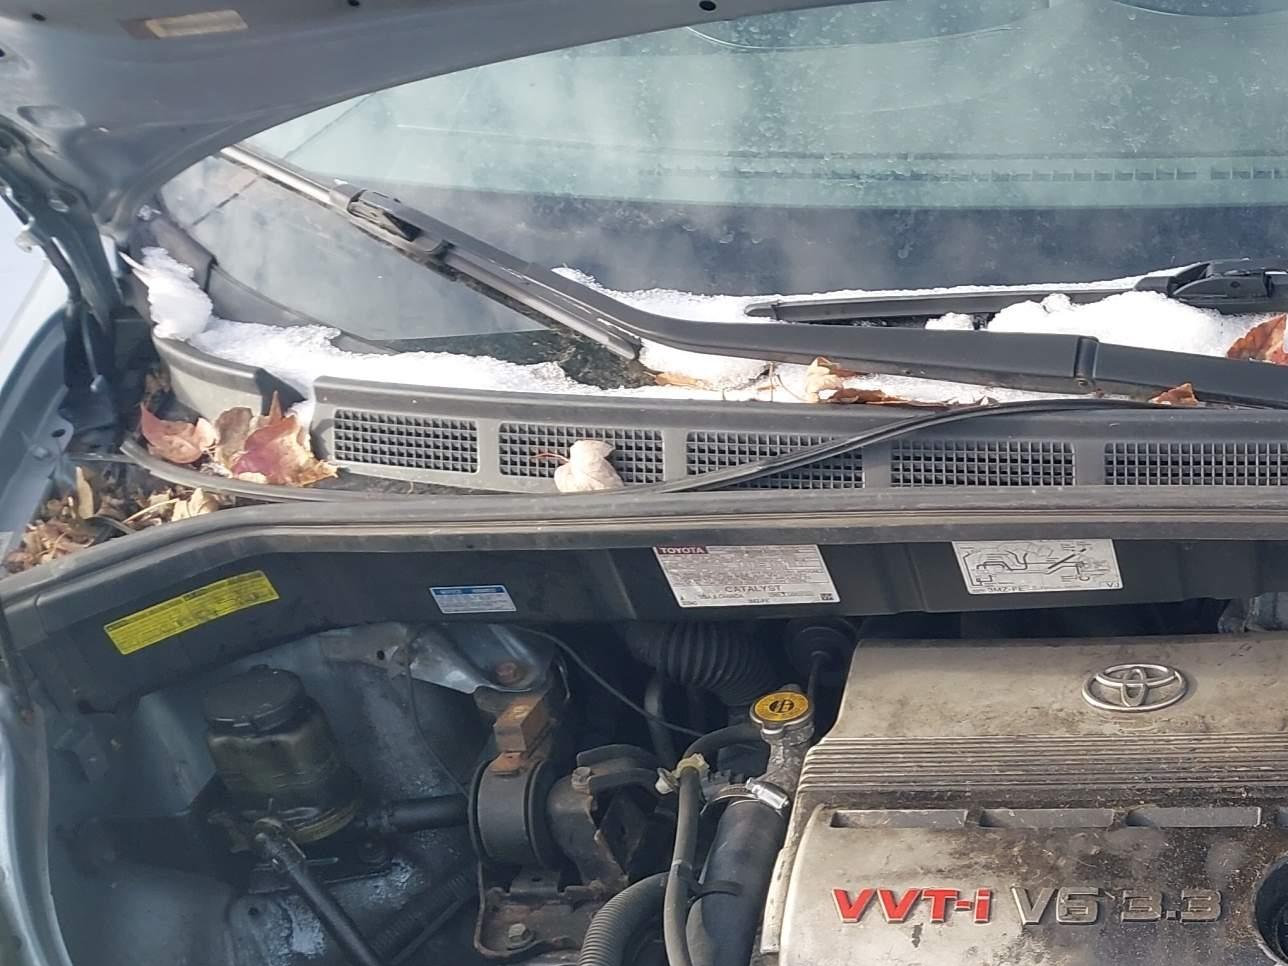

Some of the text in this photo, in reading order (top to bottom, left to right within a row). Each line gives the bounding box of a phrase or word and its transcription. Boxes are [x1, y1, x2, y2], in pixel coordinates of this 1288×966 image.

[724, 585, 782, 593] CATALYST
[831, 887, 1223, 925] VVT-i V6 3.3
